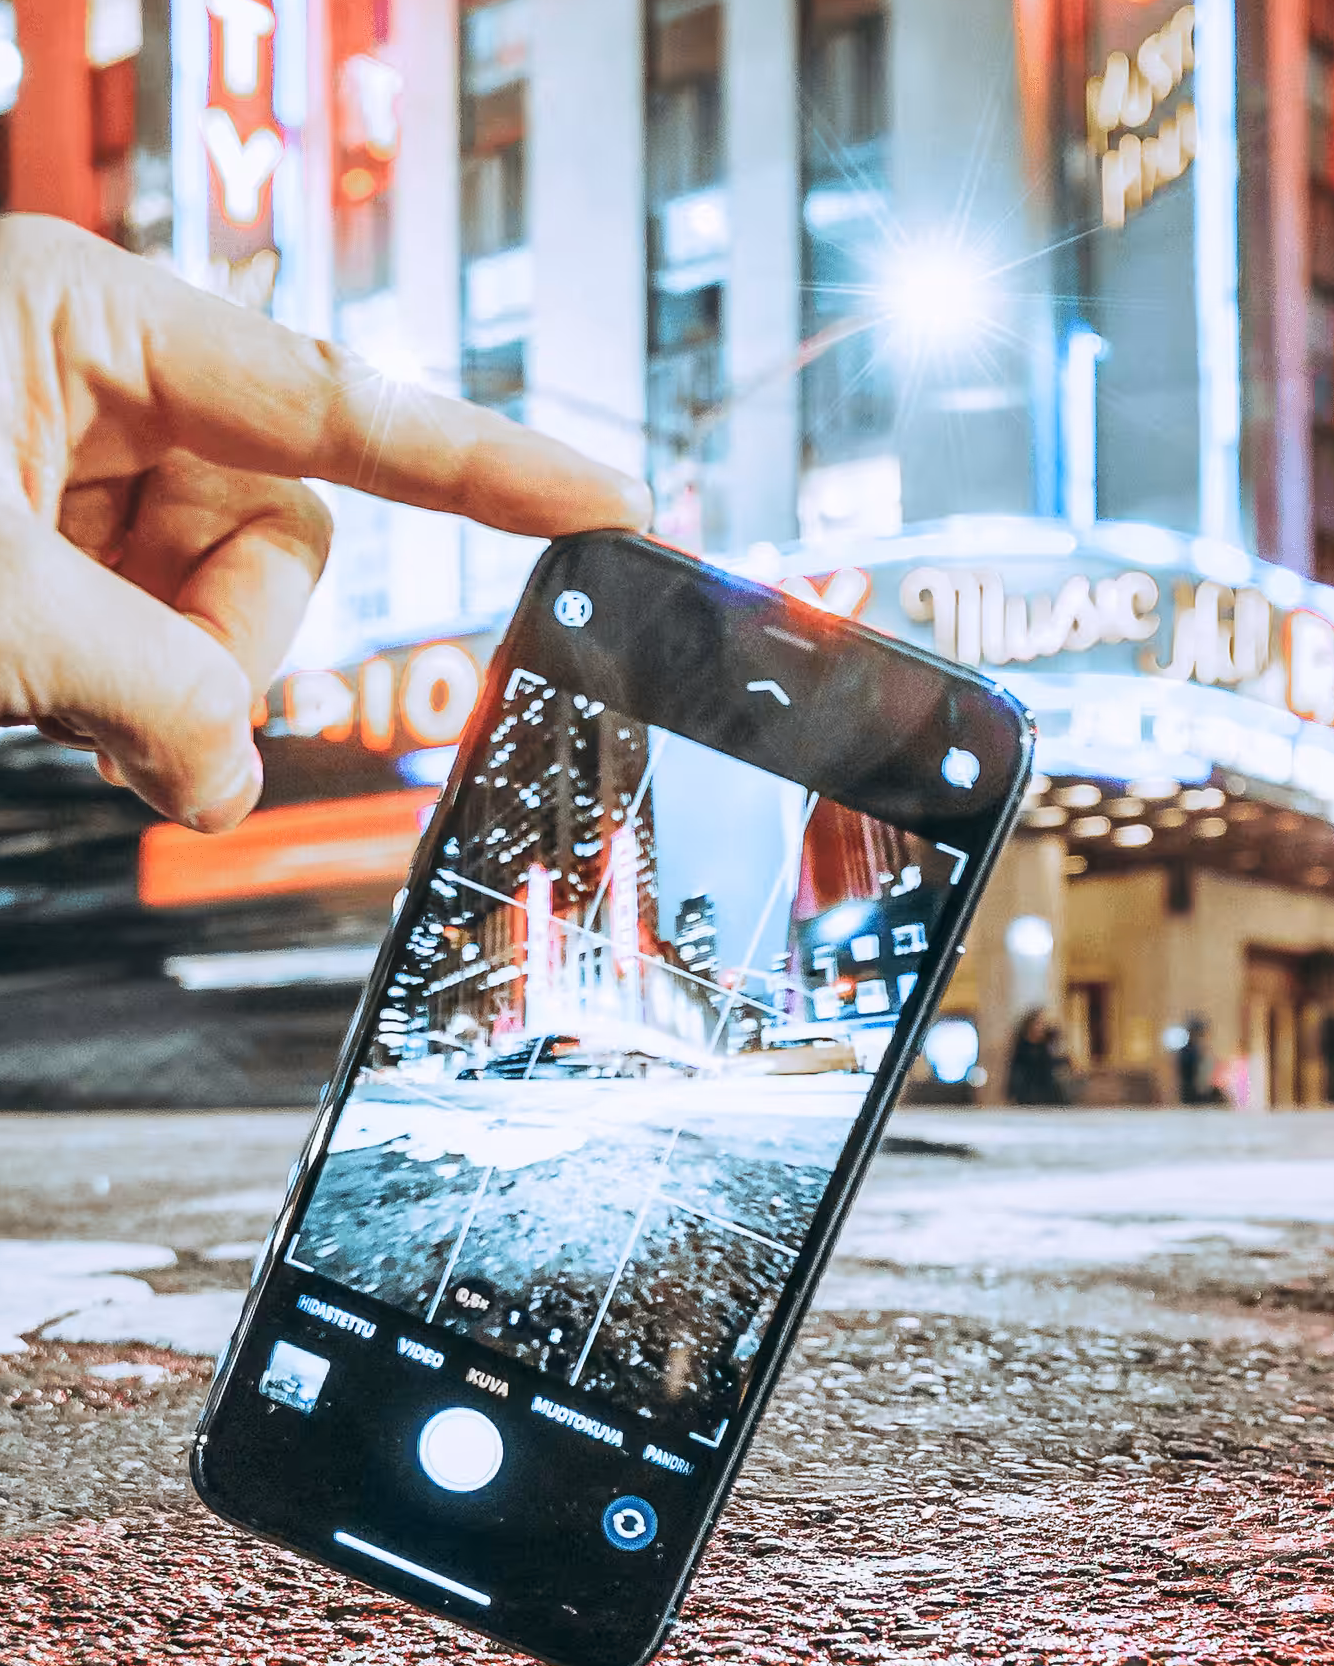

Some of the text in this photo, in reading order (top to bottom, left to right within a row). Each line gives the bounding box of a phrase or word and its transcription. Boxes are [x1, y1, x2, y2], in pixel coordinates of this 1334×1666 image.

[899, 567, 1161, 669] Music
[253, 641, 480, 751] DIO
[297, 1294, 377, 1339] HIDASTETTU
[397, 1336, 445, 1369] VIDEO
[466, 1367, 509, 1398] KUVA
[531, 1394, 624, 1447] MUOTOKUVA
